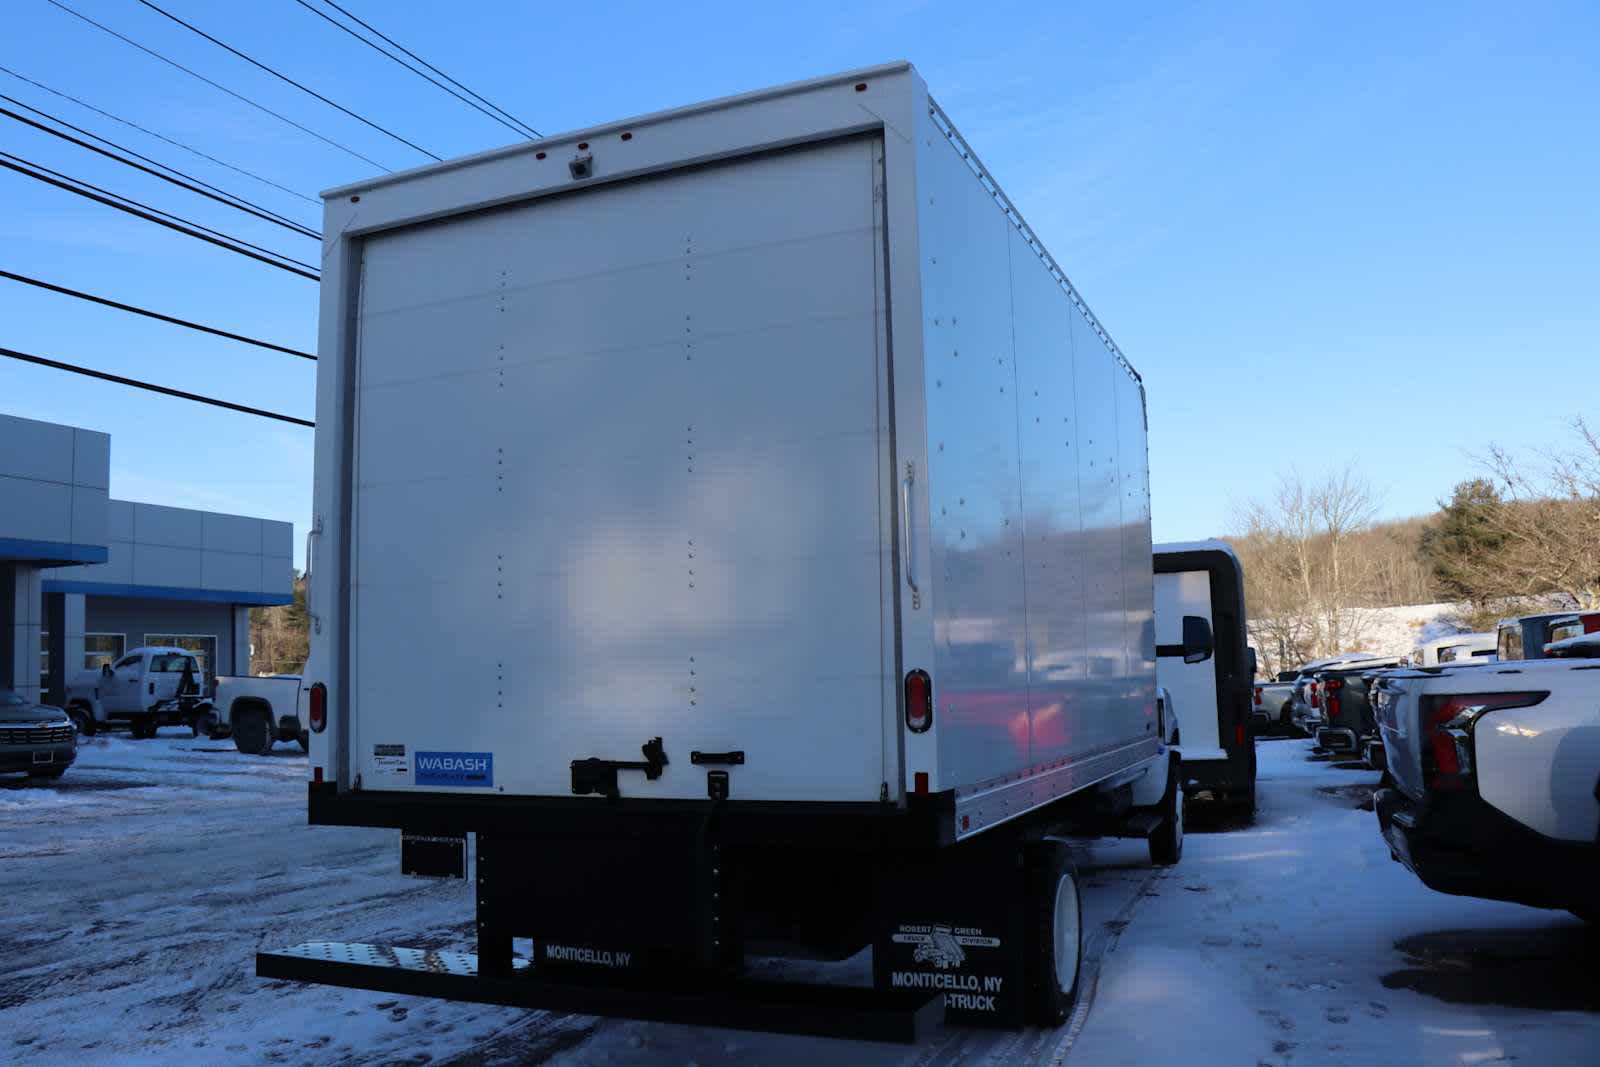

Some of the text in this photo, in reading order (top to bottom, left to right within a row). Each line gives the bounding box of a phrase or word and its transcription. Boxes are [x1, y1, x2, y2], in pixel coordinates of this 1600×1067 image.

[418, 757, 487, 771] WABASH
[899, 925, 931, 933] ROBERT
[546, 944, 631, 967] MONTICELLO, NY
[892, 972, 1002, 993] MONTICELLO, NY
